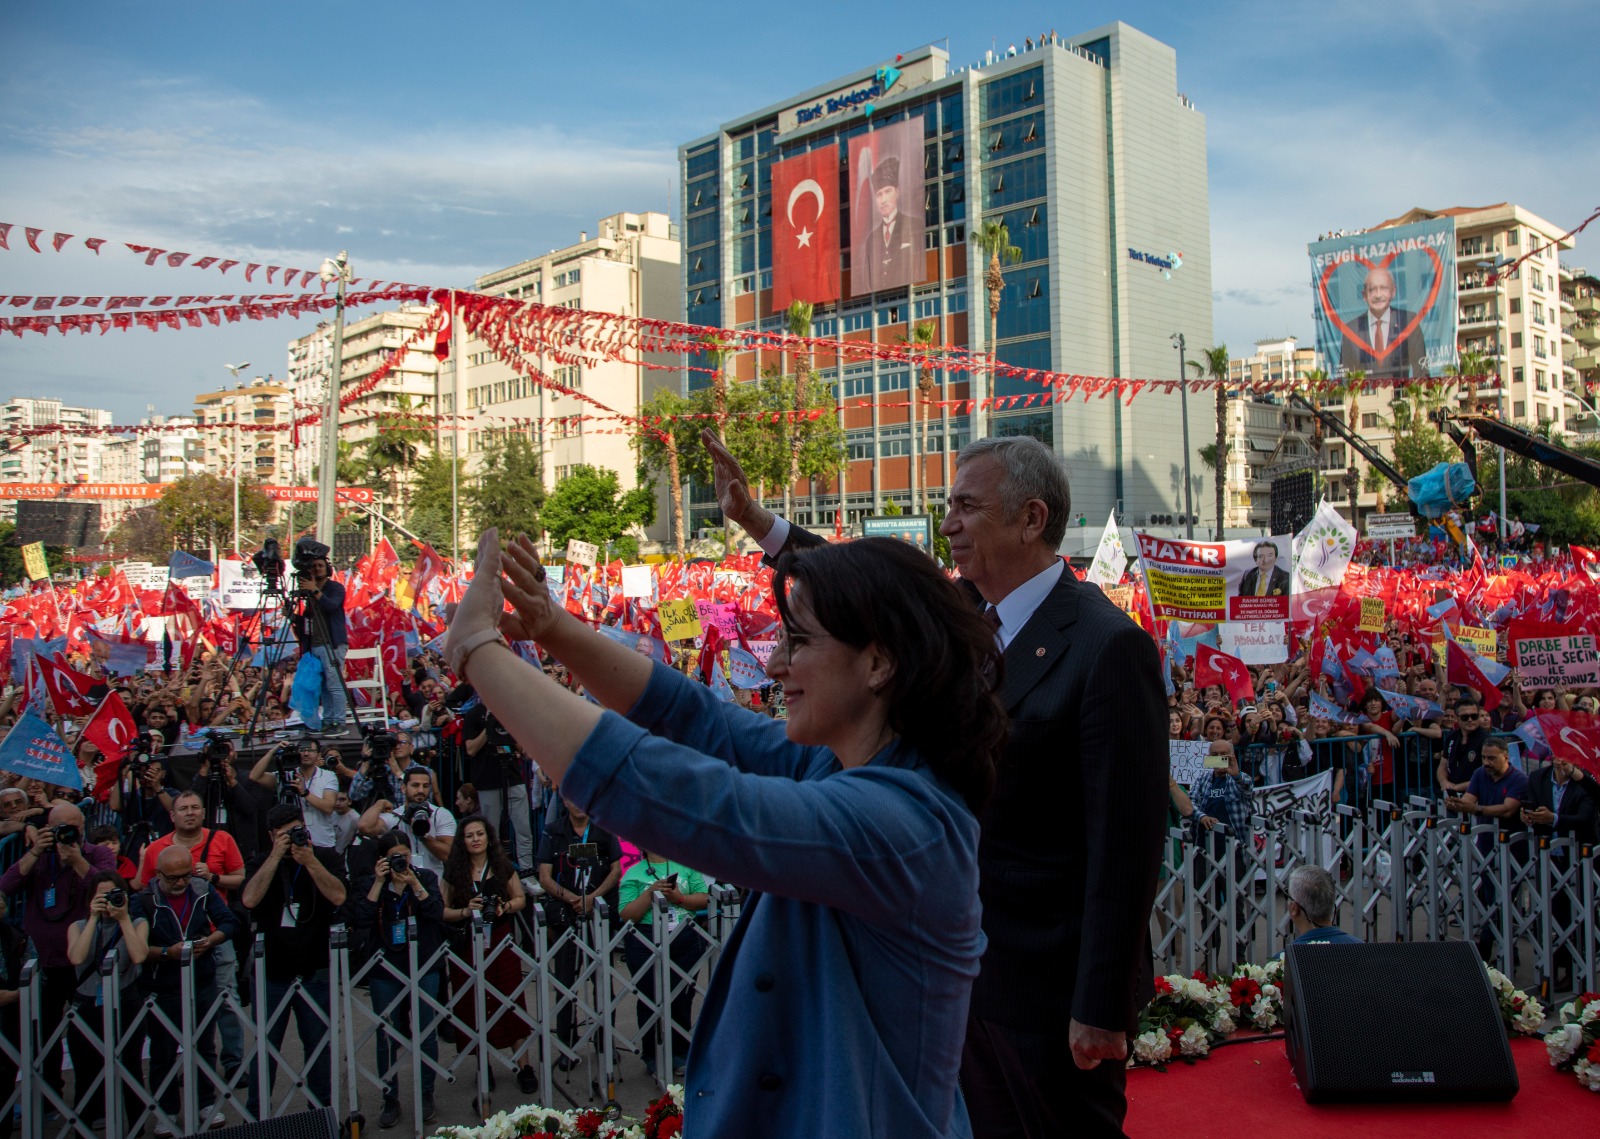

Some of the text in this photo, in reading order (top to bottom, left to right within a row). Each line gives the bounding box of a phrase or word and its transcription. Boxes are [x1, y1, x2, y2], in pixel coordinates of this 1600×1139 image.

[797, 86, 880, 124] Türk Telekom
[1316, 231, 1446, 267] SEVGİ KAZANACAK
[1128, 248, 1172, 269] Türk Telekom
[280, 489, 350, 499] CUMHUET
[1142, 539, 1220, 565] HAYIR
[1180, 610, 1217, 619] İTTİFAKI
[1519, 636, 1591, 654] DARBE İLE
[1521, 650, 1598, 666] DEĞİL SEÇİM
[1548, 665, 1565, 675] İLE
[1522, 672, 1598, 687] GİDİYORSUNUZ
[32, 738, 64, 753] SANA
[1171, 741, 1191, 753] HER
[26, 748, 61, 763] SÖZ!
